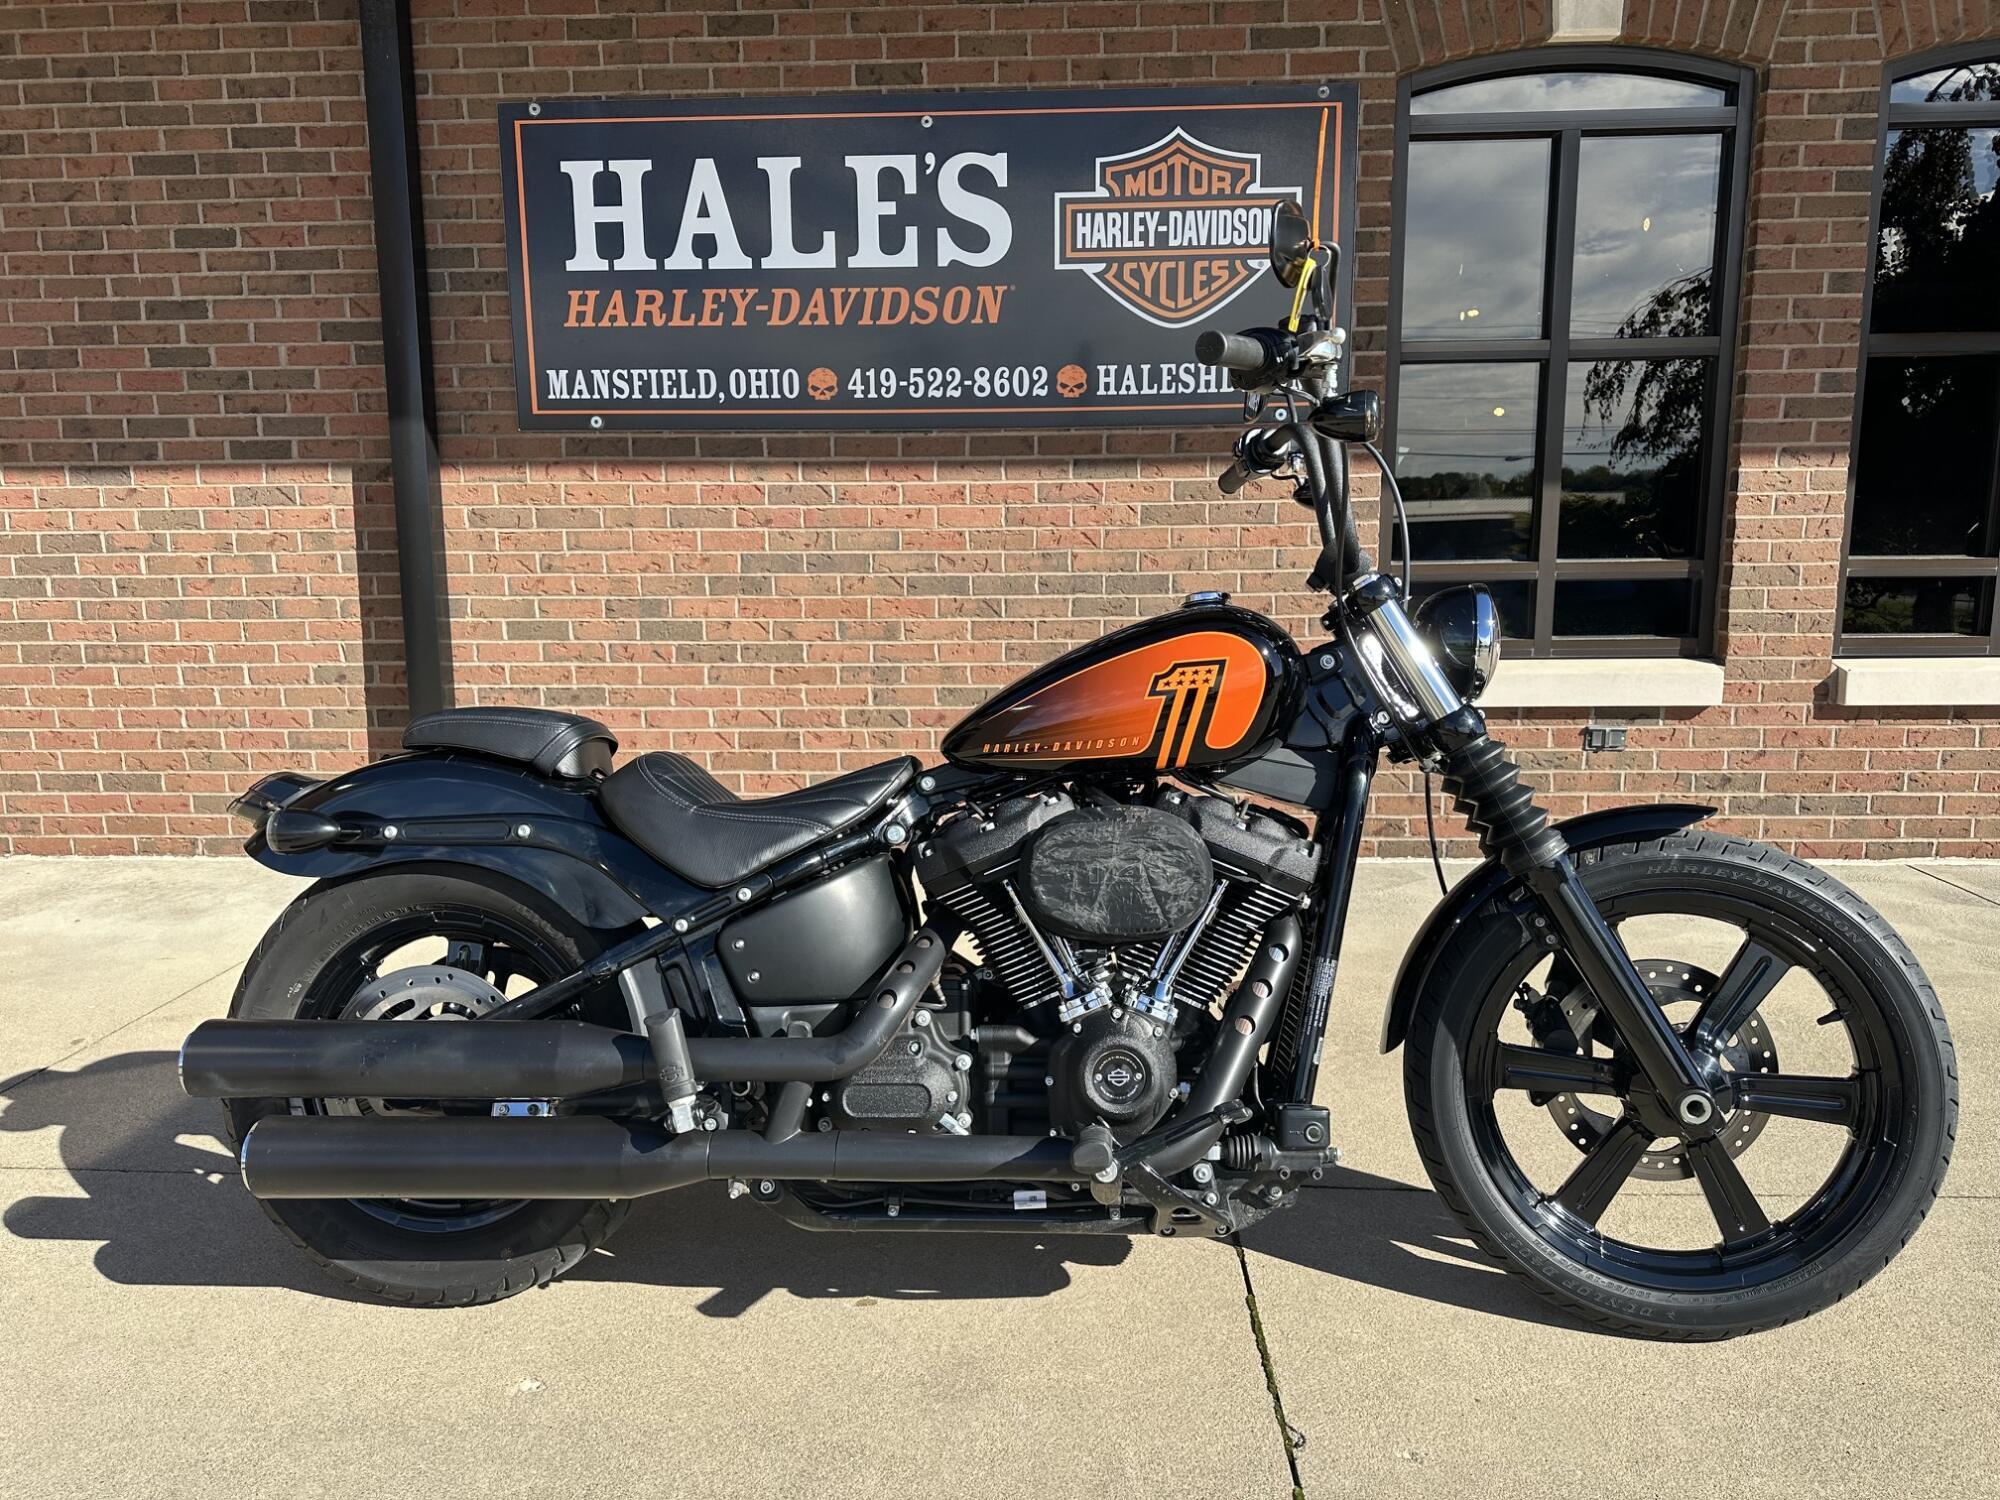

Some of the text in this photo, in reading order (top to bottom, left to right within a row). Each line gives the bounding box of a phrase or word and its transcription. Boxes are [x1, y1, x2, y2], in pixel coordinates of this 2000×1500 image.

[1124, 152, 1232, 197] MOTOR
[559, 151, 1013, 272] HALE'S
[563, 285, 1008, 328] HARLEY-DAVIDSON
[1123, 259, 1230, 309] CYCLES
[847, 365, 1049, 399] 419-522-8602
[982, 736, 1140, 753] HARLEY-DAVIDSON
[1647, 864, 1868, 944] HARLEY-DAVIDSON
